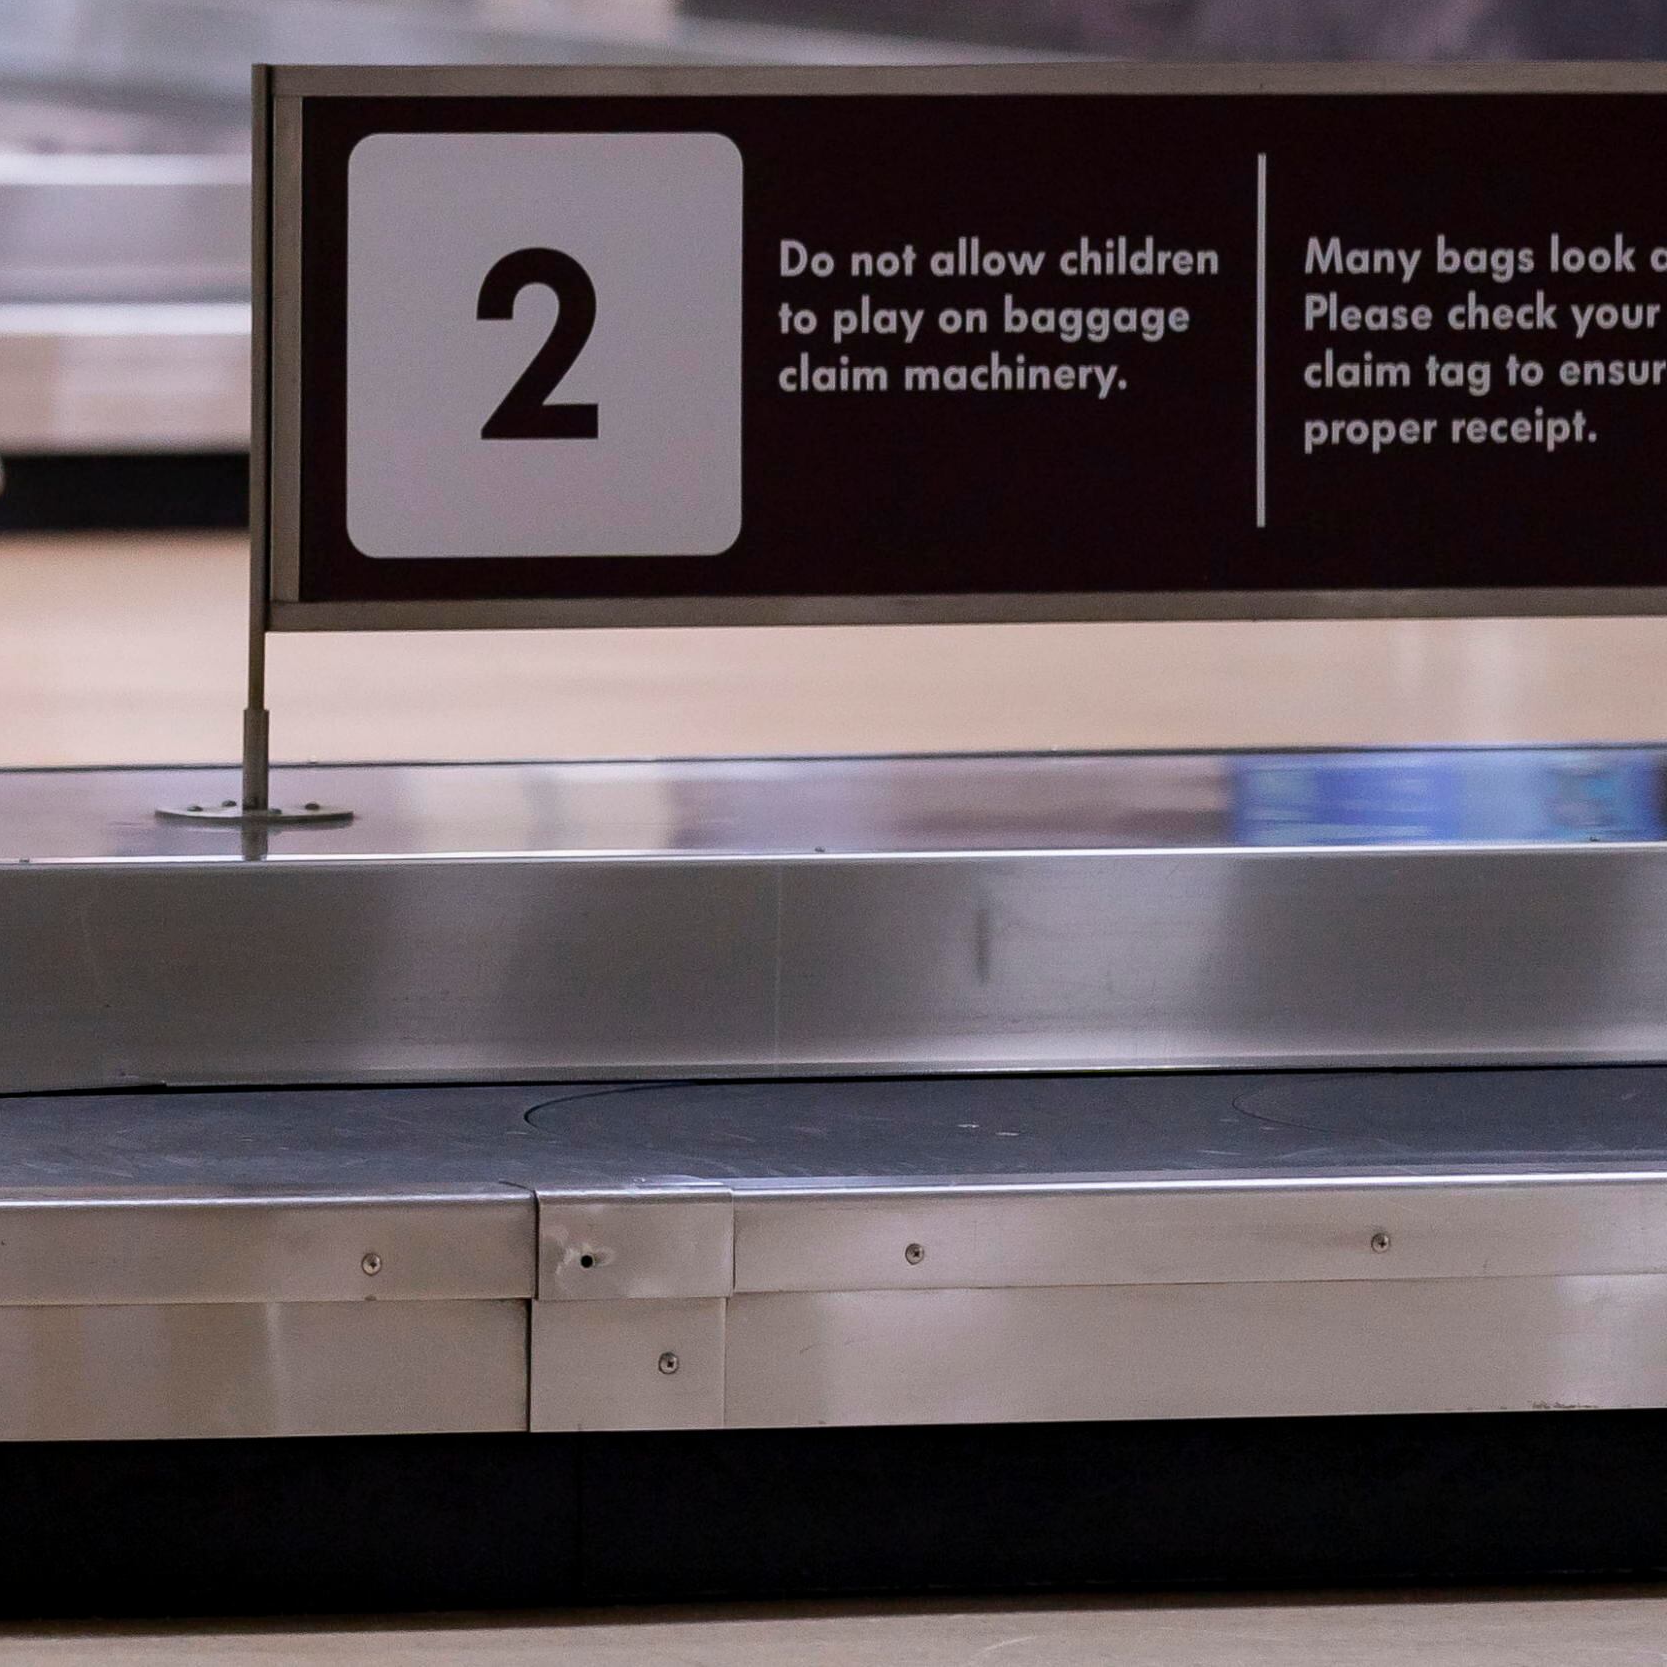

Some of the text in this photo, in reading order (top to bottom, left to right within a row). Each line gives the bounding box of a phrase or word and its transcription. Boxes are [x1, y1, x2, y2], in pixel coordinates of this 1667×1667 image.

[781, 236, 1218, 276] Do not allow children
[1305, 237, 1421, 283] Many
[1437, 235, 1534, 282] bags
[1551, 234, 1635, 272] look
[779, 294, 1189, 343] to play on baggage
[1305, 290, 1660, 338] Please check your
[476, 246, 599, 441] 2
[779, 351, 1126, 399] claim machinery.
[1304, 349, 1666, 396] claim tag to ensur
[1305, 407, 1596, 454] proper receipt.
